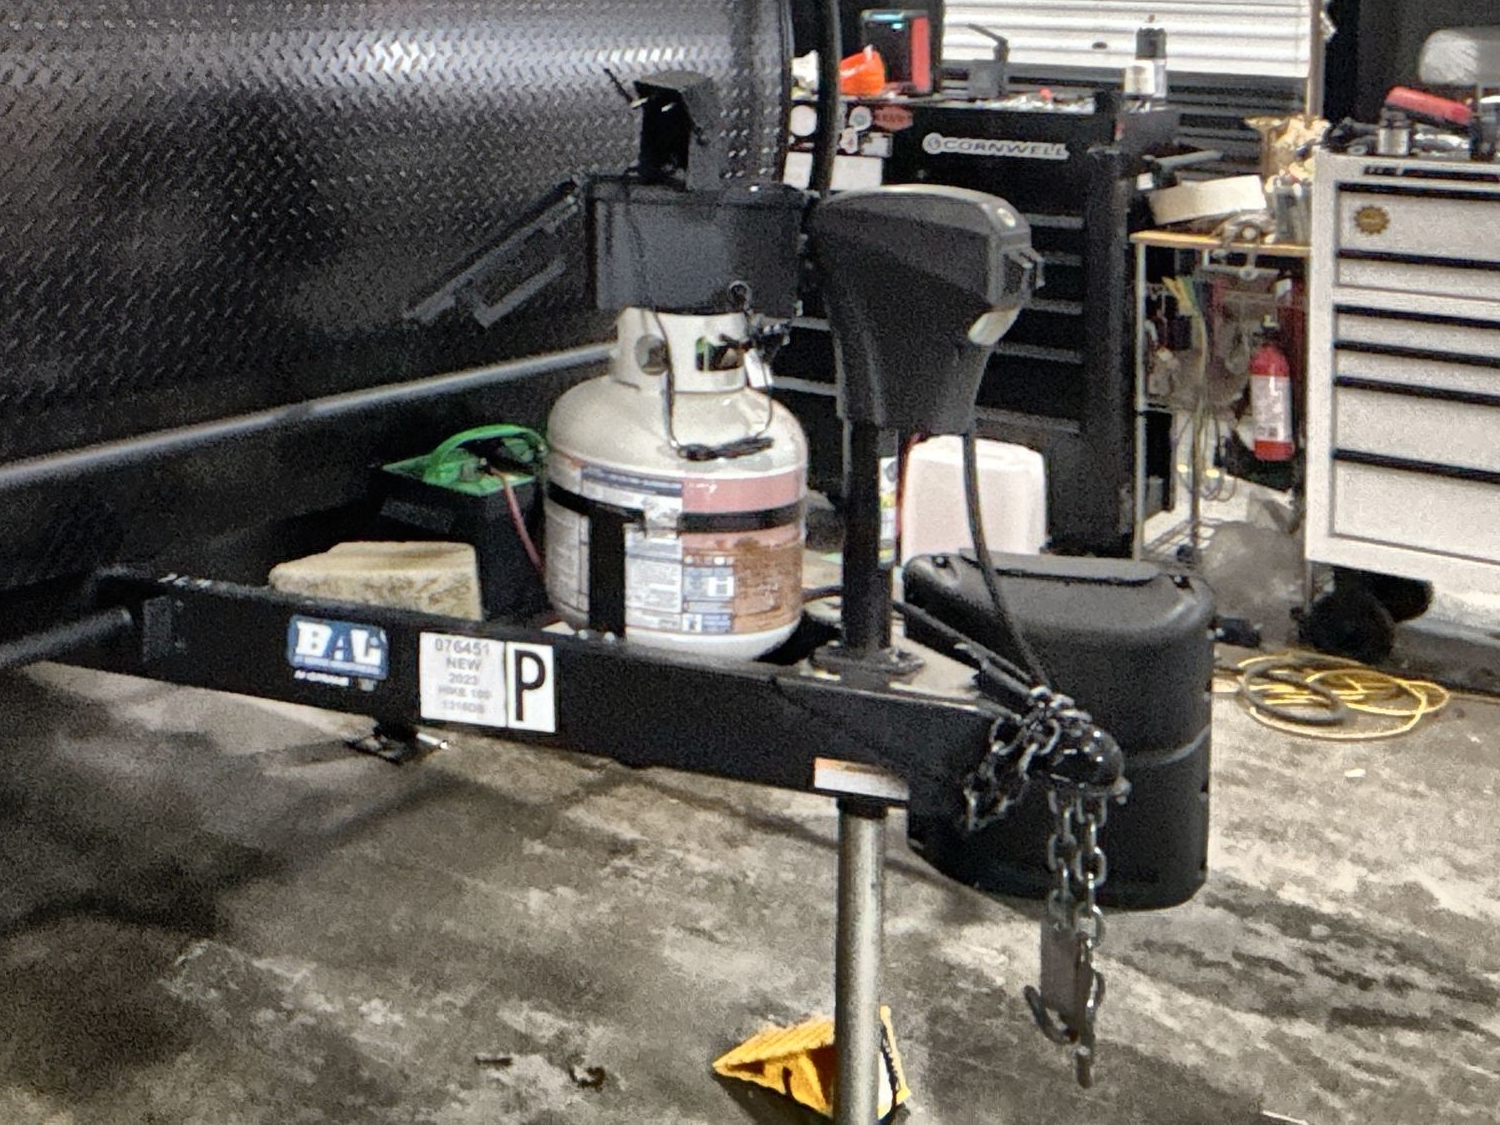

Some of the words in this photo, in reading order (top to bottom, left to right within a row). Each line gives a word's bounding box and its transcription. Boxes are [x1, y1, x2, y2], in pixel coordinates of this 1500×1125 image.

[943, 139, 1066, 158] CORNWELL
[295, 621, 382, 667] BAL
[434, 637, 491, 657] 076451
[446, 657, 482, 672] NEW
[514, 649, 546, 722] P
